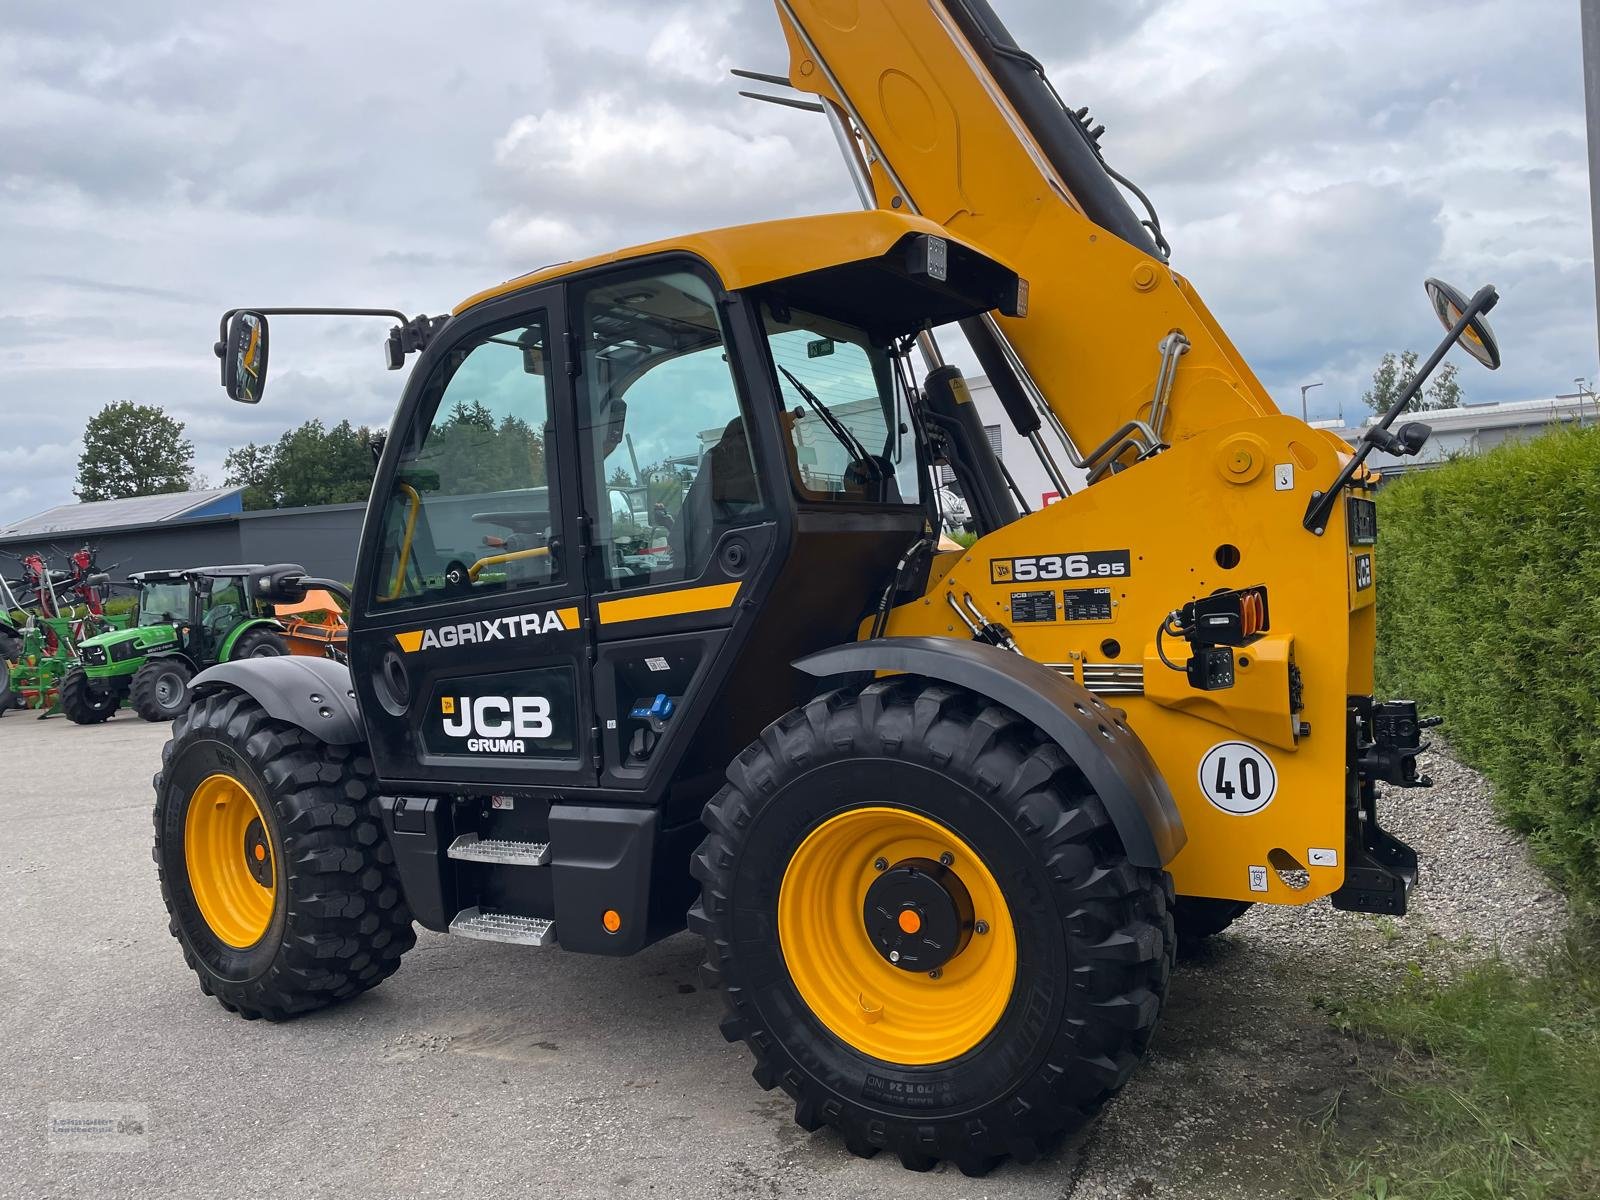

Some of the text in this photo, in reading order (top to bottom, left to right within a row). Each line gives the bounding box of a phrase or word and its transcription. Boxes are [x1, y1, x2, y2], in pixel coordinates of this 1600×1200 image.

[421, 610, 564, 650] AGRIXTRA
[442, 696, 553, 738] JCB
[467, 738, 525, 753] GRUMA
[1215, 757, 1261, 800] 40
